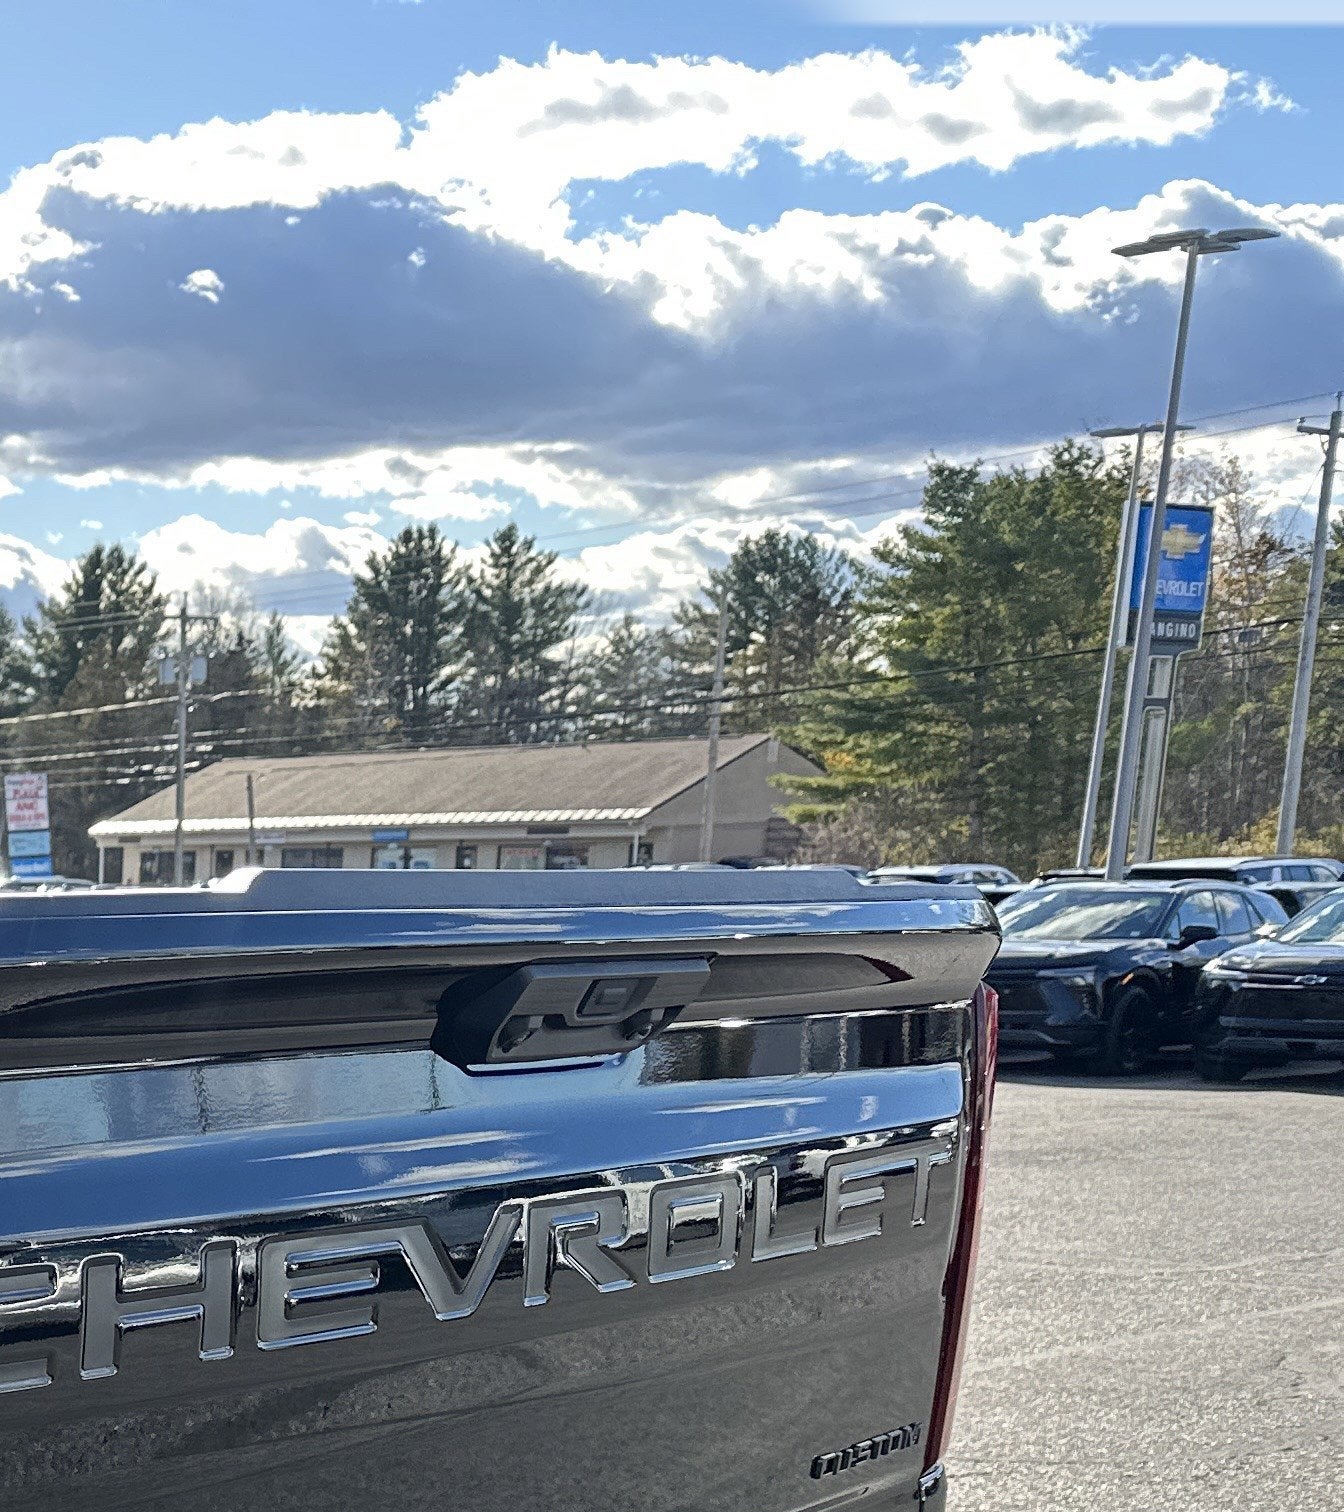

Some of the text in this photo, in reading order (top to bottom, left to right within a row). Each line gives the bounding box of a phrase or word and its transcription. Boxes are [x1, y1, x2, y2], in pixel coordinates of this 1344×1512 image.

[1155, 579, 1205, 597] EVROLET
[1150, 621, 1196, 638] ANGINO
[810, 1421, 923, 1480] CUSTOM
